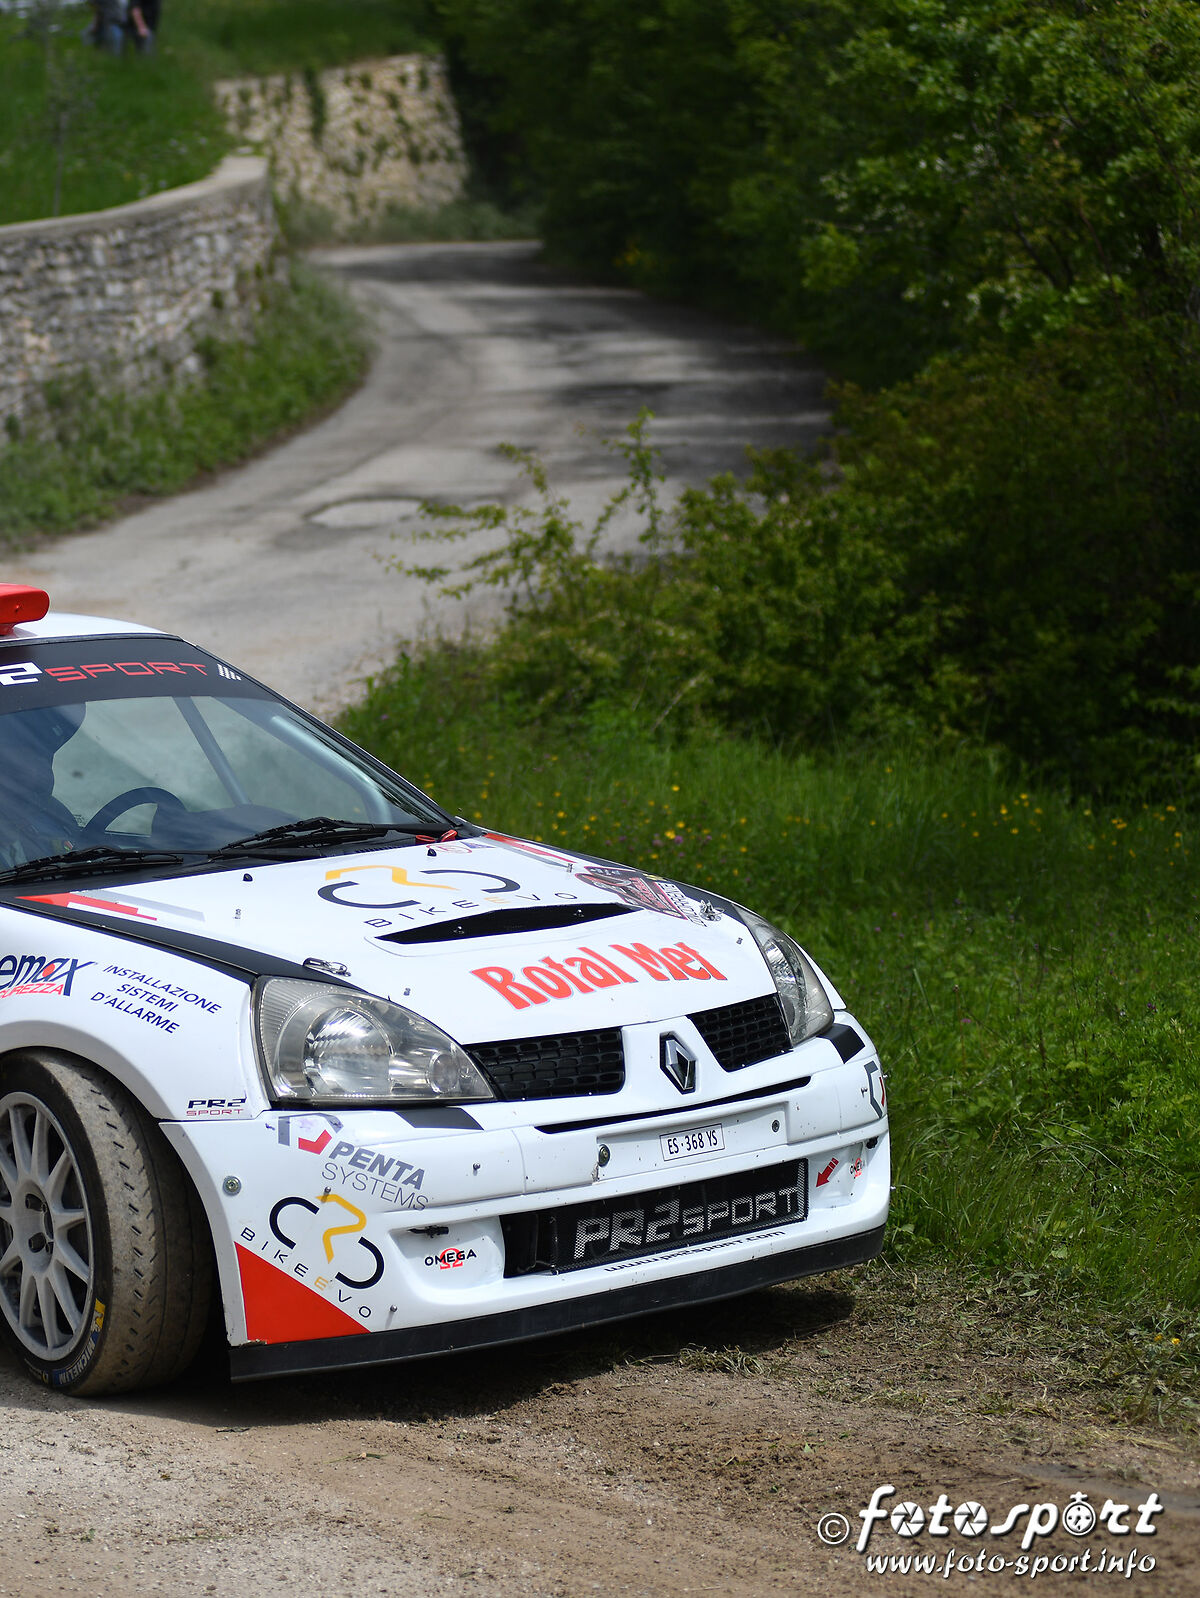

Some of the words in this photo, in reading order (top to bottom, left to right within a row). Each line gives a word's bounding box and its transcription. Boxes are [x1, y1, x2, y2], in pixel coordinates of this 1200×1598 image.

[45, 661, 208, 682] SPORT
[102, 963, 222, 1015] INSTALLAZIONE
[116, 982, 178, 1013] SISTEMI
[470, 946, 639, 1010] Rotal
[608, 941, 729, 982] Met
[90, 991, 181, 1035] D'ALLARME
[185, 1108, 245, 1117] SPORT
[187, 1097, 247, 1109] PR2
[685, 1132, 705, 1151] 368
[706, 1129, 719, 1147] YS
[321, 1161, 430, 1212] SYSTEMS
[327, 1140, 428, 1191] PENTA
[573, 1198, 680, 1260] PR2
[682, 1185, 800, 1236] SPORT
[423, 1248, 478, 1268] OMEGA
[58, 1337, 97, 1385] MICHELIN
